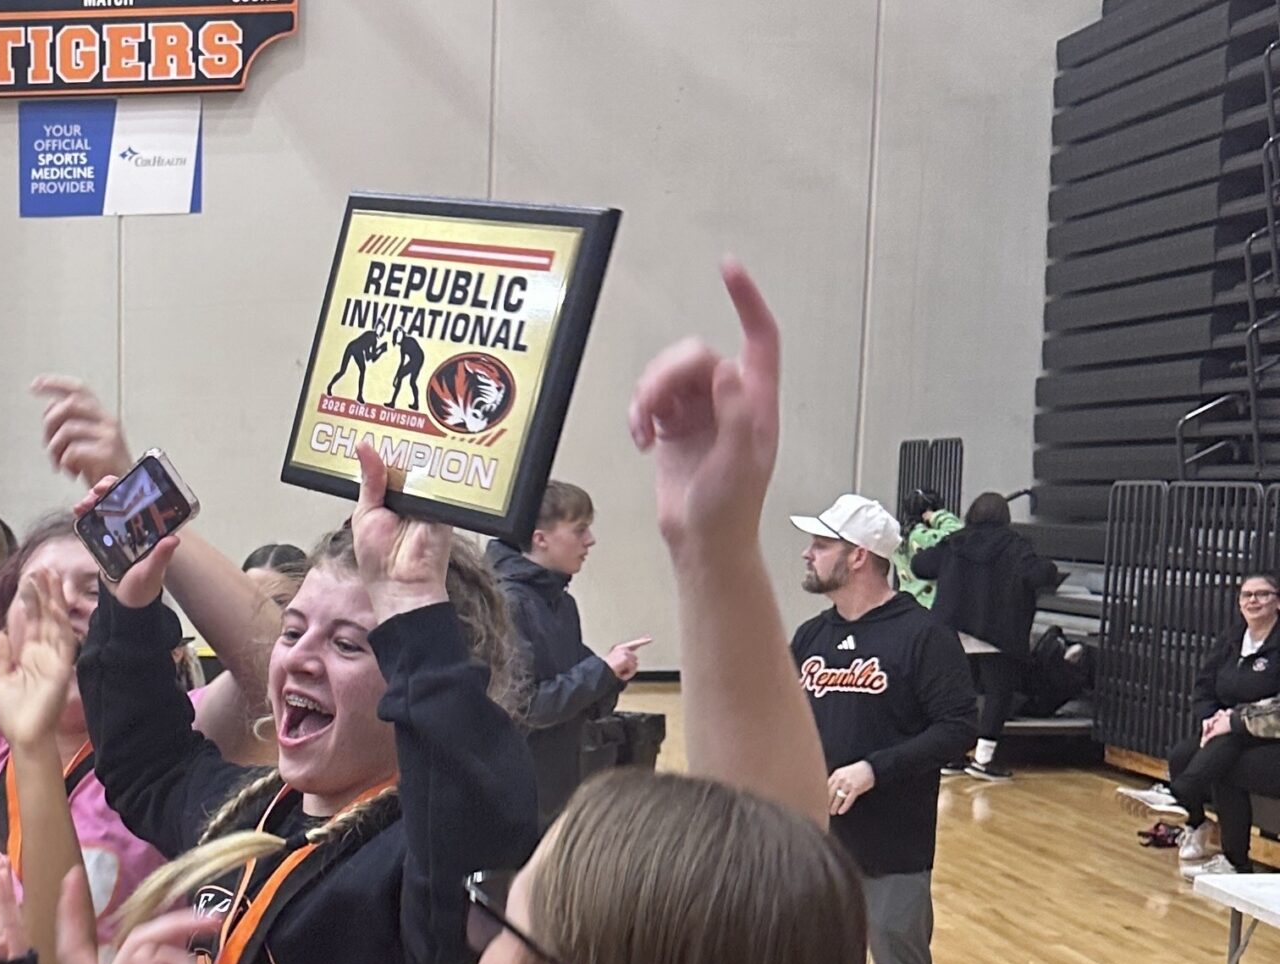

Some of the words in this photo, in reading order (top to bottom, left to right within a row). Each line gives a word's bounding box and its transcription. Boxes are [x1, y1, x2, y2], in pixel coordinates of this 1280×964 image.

[43, 124, 82, 137] YOUR
[34, 139, 92, 152] OFFICIAL
[38, 153, 88, 166] SPORTS
[31, 166, 95, 180] MEDICINE
[30, 181, 96, 194] PROVIDER
[363, 260, 529, 313] REPUBLIC
[340, 298, 529, 352] INVITATIONAL
[321, 398, 346, 413] 2026
[348, 403, 378, 420] GIRLS
[380, 409, 426, 428] DIVISION
[310, 421, 498, 490] CHAMPION
[801, 655, 888, 698] Republic
